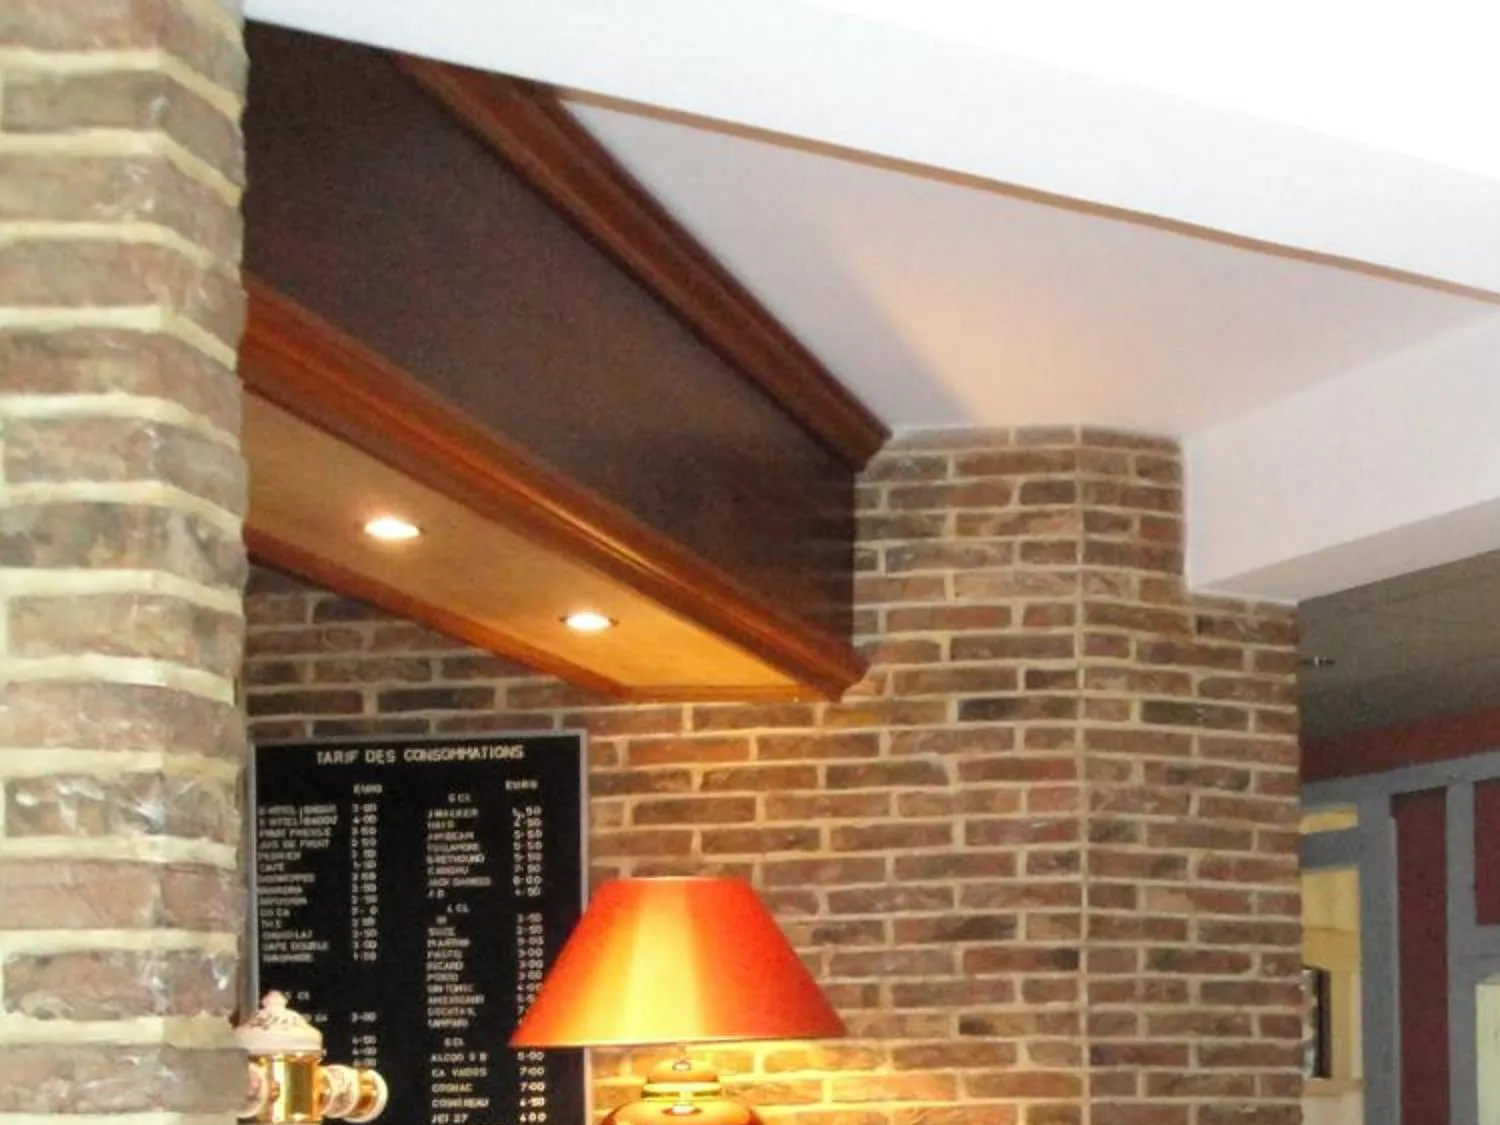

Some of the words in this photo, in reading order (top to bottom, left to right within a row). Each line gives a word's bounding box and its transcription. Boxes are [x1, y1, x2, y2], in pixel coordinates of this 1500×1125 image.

[316, 750, 359, 765] TARIF
[365, 748, 397, 765] DES
[403, 745, 525, 762] CONSOMMATIONS
